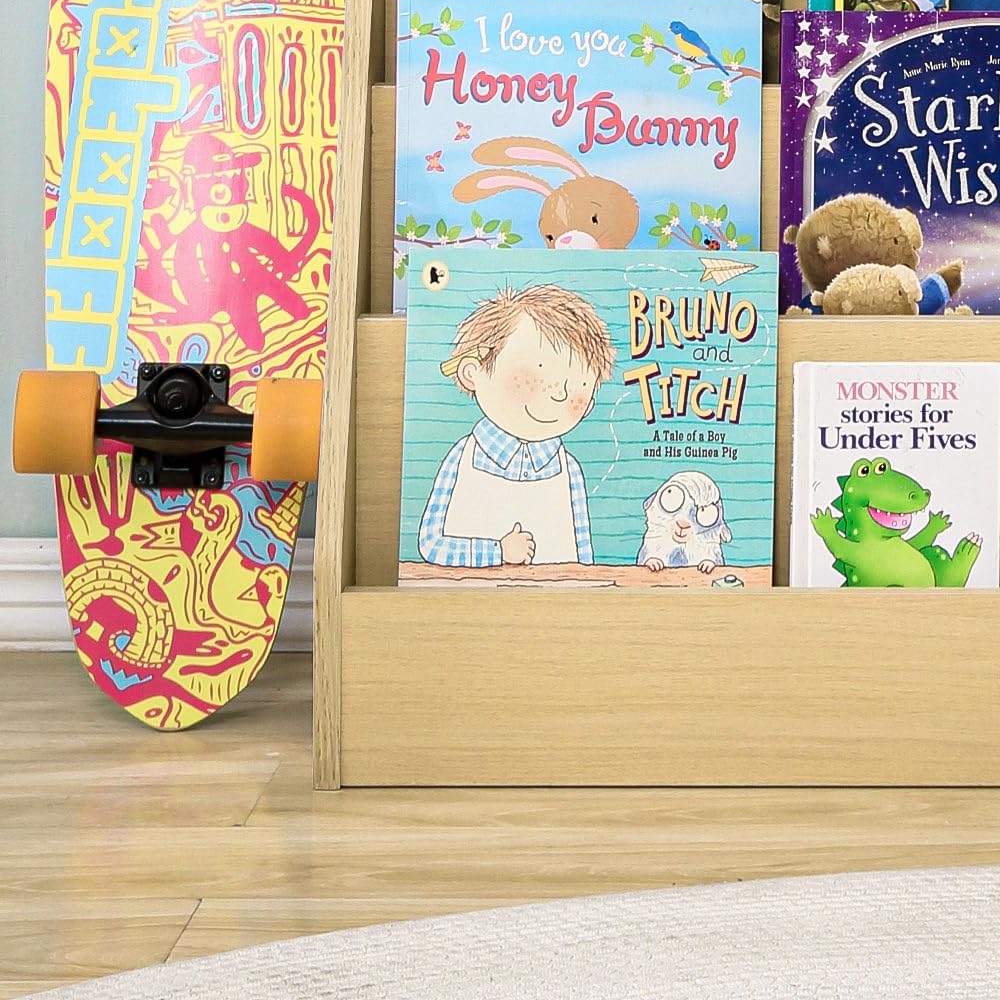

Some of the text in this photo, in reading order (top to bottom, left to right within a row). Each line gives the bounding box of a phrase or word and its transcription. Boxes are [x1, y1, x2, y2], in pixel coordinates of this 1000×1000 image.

[474, 11, 629, 68] I love you
[903, 68, 922, 79] Anne
[924, 61, 948, 72] Marie
[951, 57, 970, 70] Ryan
[422, 48, 578, 127] Honey
[577, 91, 739, 170] Bunny
[628, 289, 758, 360] BRUNO
[692, 343, 733, 363] and
[624, 363, 746, 424] TITCH
[837, 381, 959, 401] MONSTER
[840, 403, 953, 424] stories for
[653, 430, 726, 444] A Tale of a Boy
[818, 426, 977, 450] Under Fives
[643, 446, 737, 460] and His Guinea Pig
